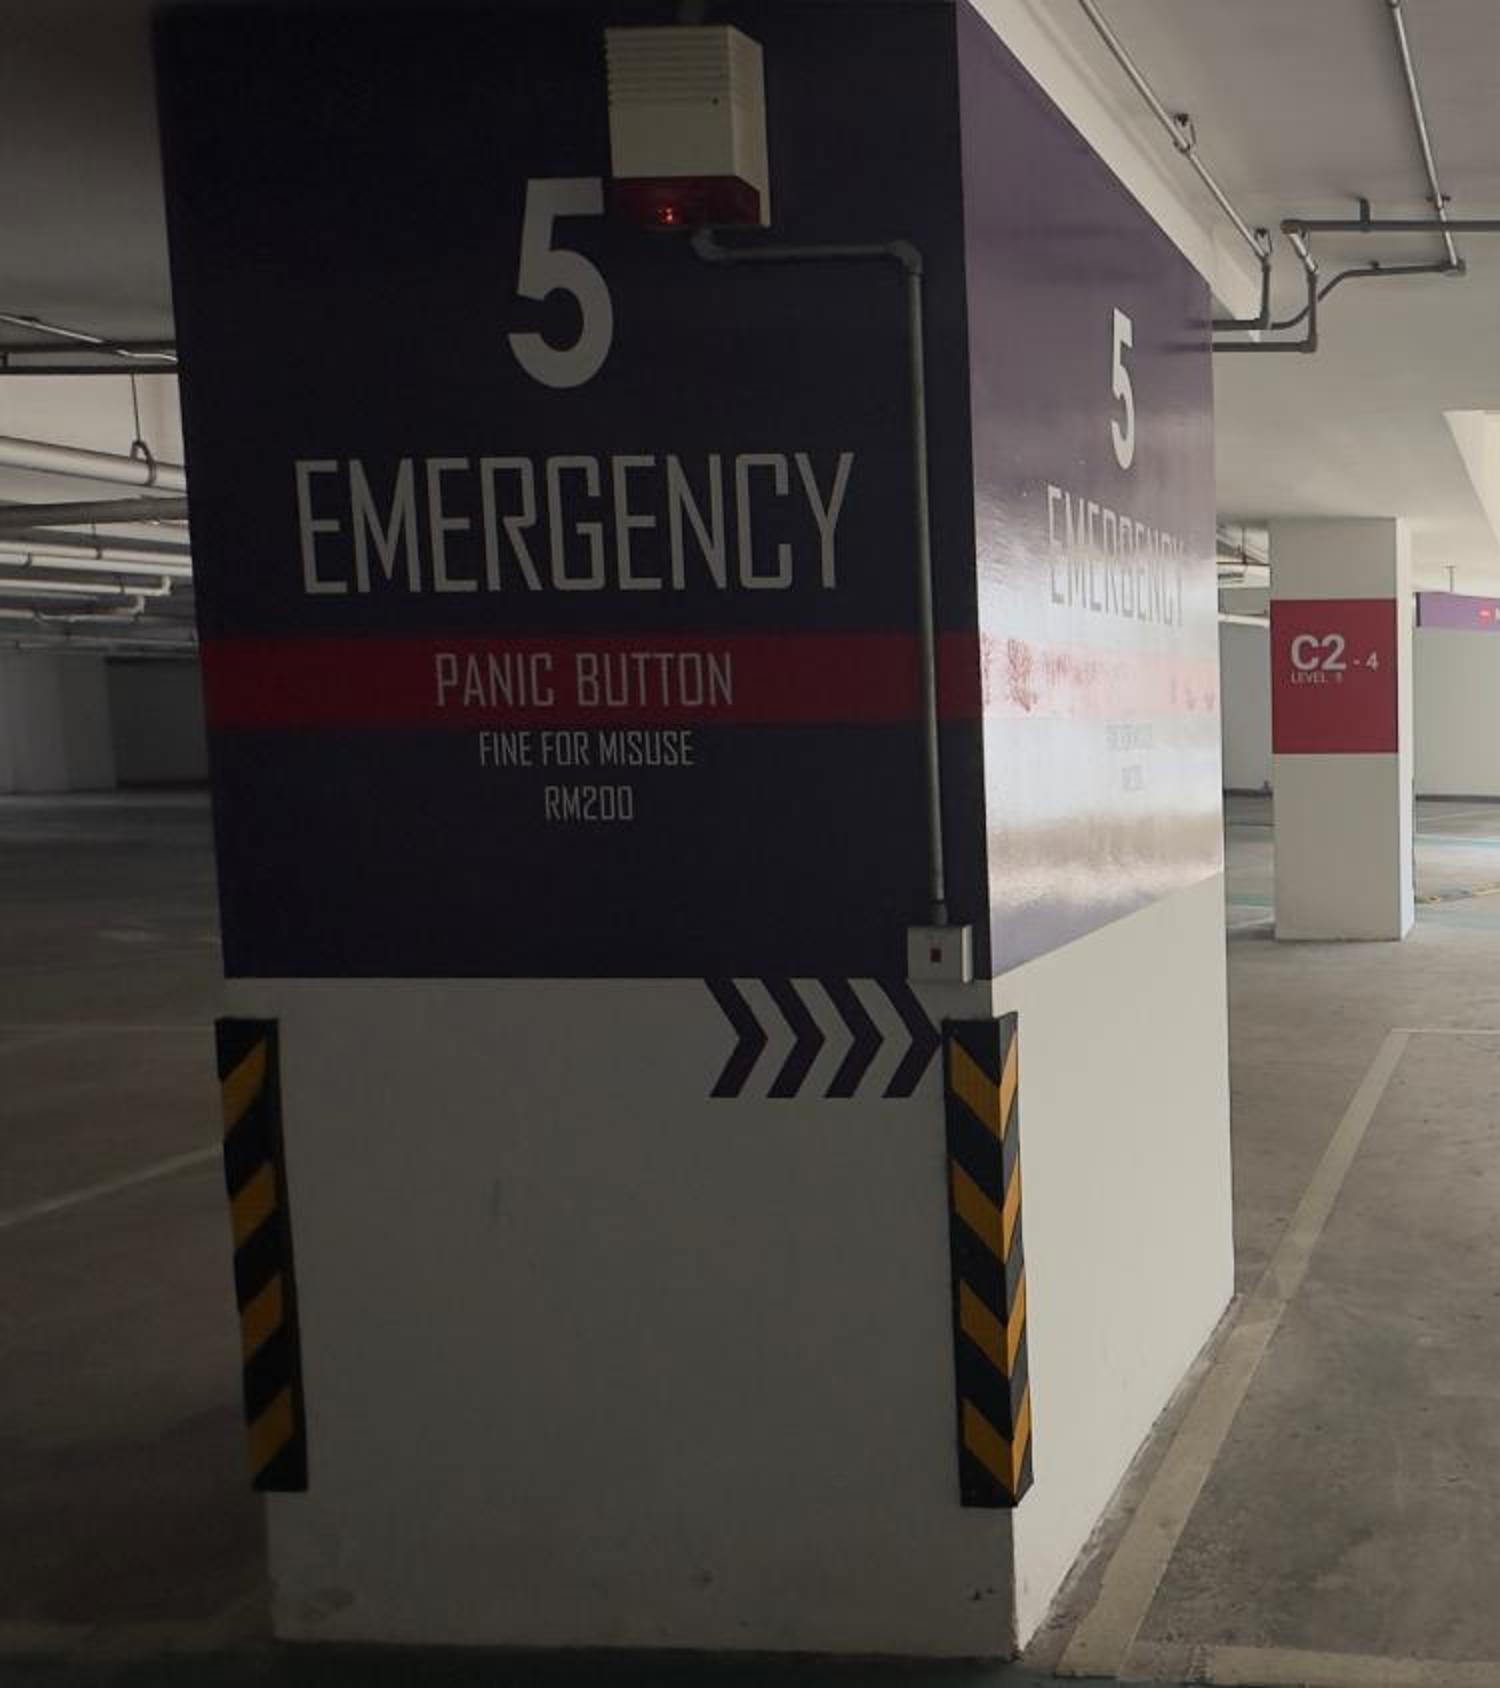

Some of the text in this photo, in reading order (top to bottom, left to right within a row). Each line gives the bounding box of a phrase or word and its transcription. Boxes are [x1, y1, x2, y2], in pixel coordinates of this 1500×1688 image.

[508, 177, 614, 389] 5
[1111, 306, 1135, 470] 5
[294, 452, 855, 595] EMERGENCY
[1290, 633, 1347, 671] C2
[435, 651, 734, 707] PANIC BUTTON
[1291, 671, 1328, 684] LEVEL
[480, 731, 695, 768] FINE FOR MISUSE
[544, 785, 634, 821] RM200
